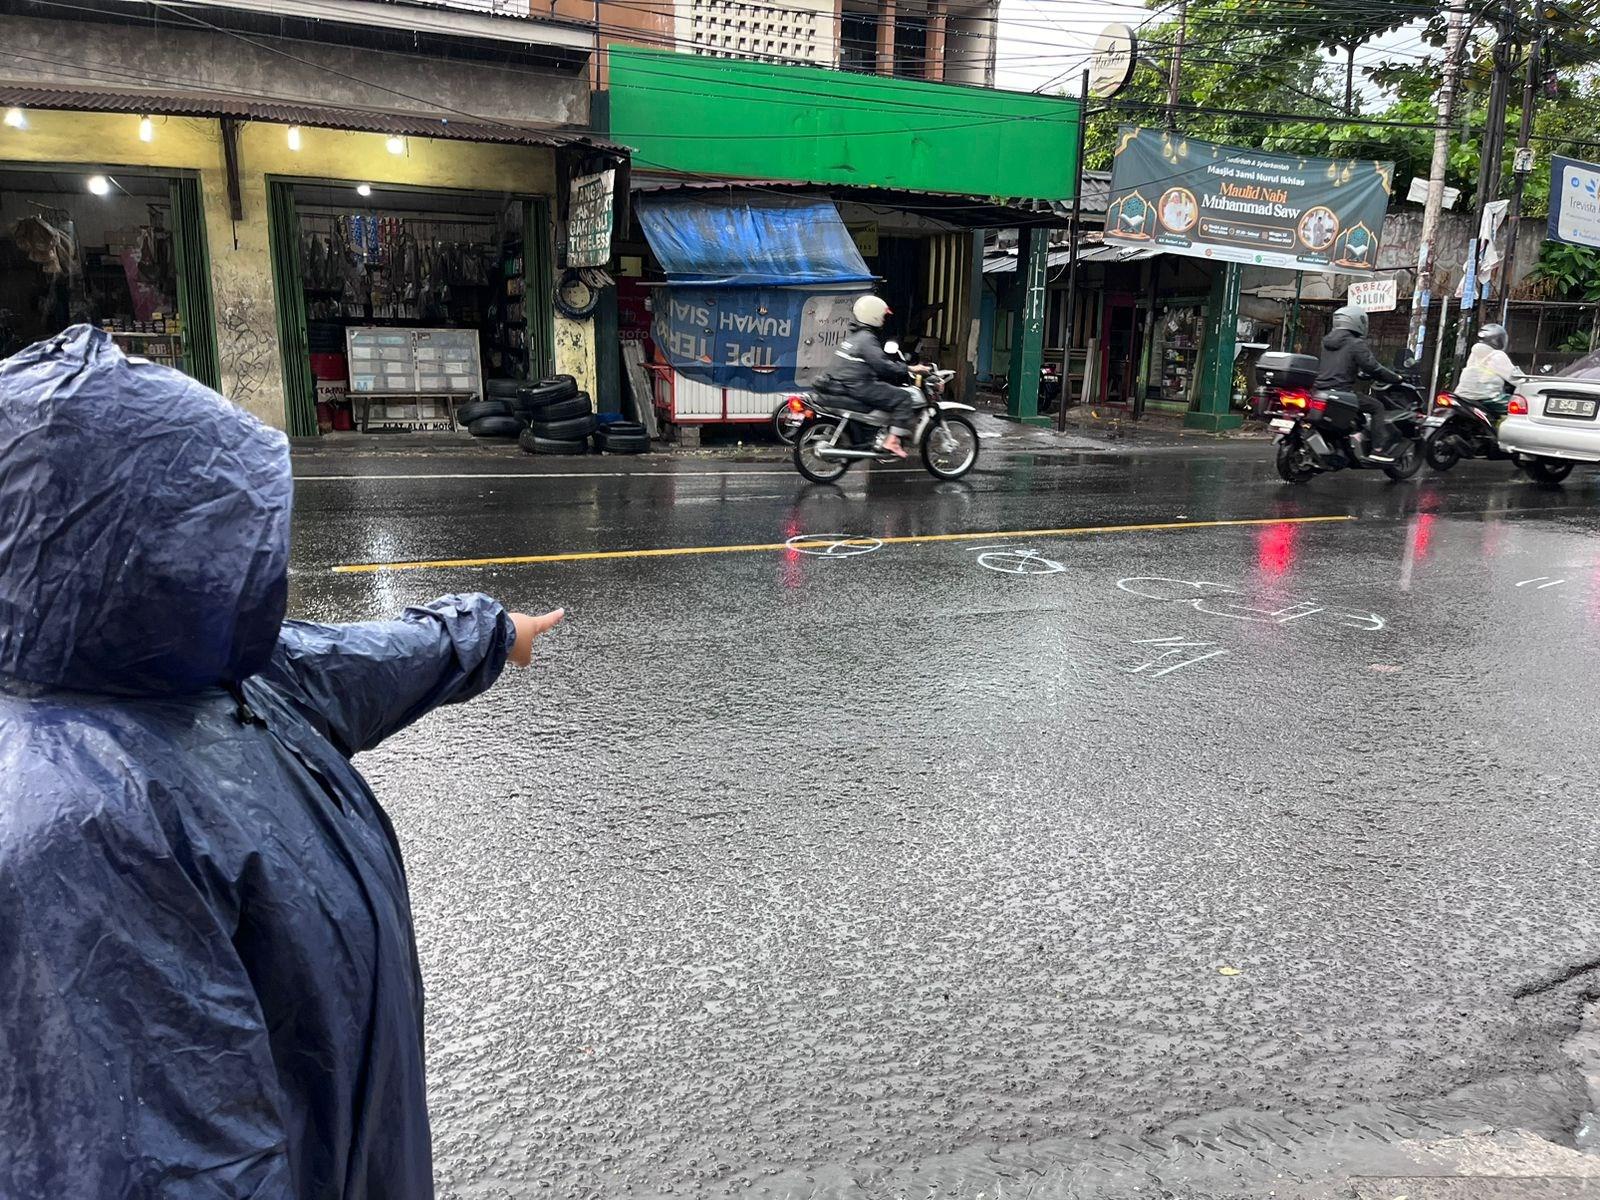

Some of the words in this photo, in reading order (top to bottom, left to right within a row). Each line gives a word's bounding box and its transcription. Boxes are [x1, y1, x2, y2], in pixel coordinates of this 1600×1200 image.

[1207, 165, 1234, 177] Masjid
[1235, 169, 1255, 179] Jami
[1256, 172, 1279, 183] Nurul
[1280, 176, 1305, 186] Ikhlas
[1219, 182, 1260, 200] Maulid
[1260, 188, 1288, 204] Nabi
[1201, 193, 1273, 216] Muhammad
[1273, 203, 1301, 219] Saw
[1356, 292, 1385, 305] SALON
[720, 311, 792, 338] RUMAH
[818, 330, 846, 347] Hills
[725, 342, 773, 367] TIPE
[433, 422, 453, 431] MOTO
